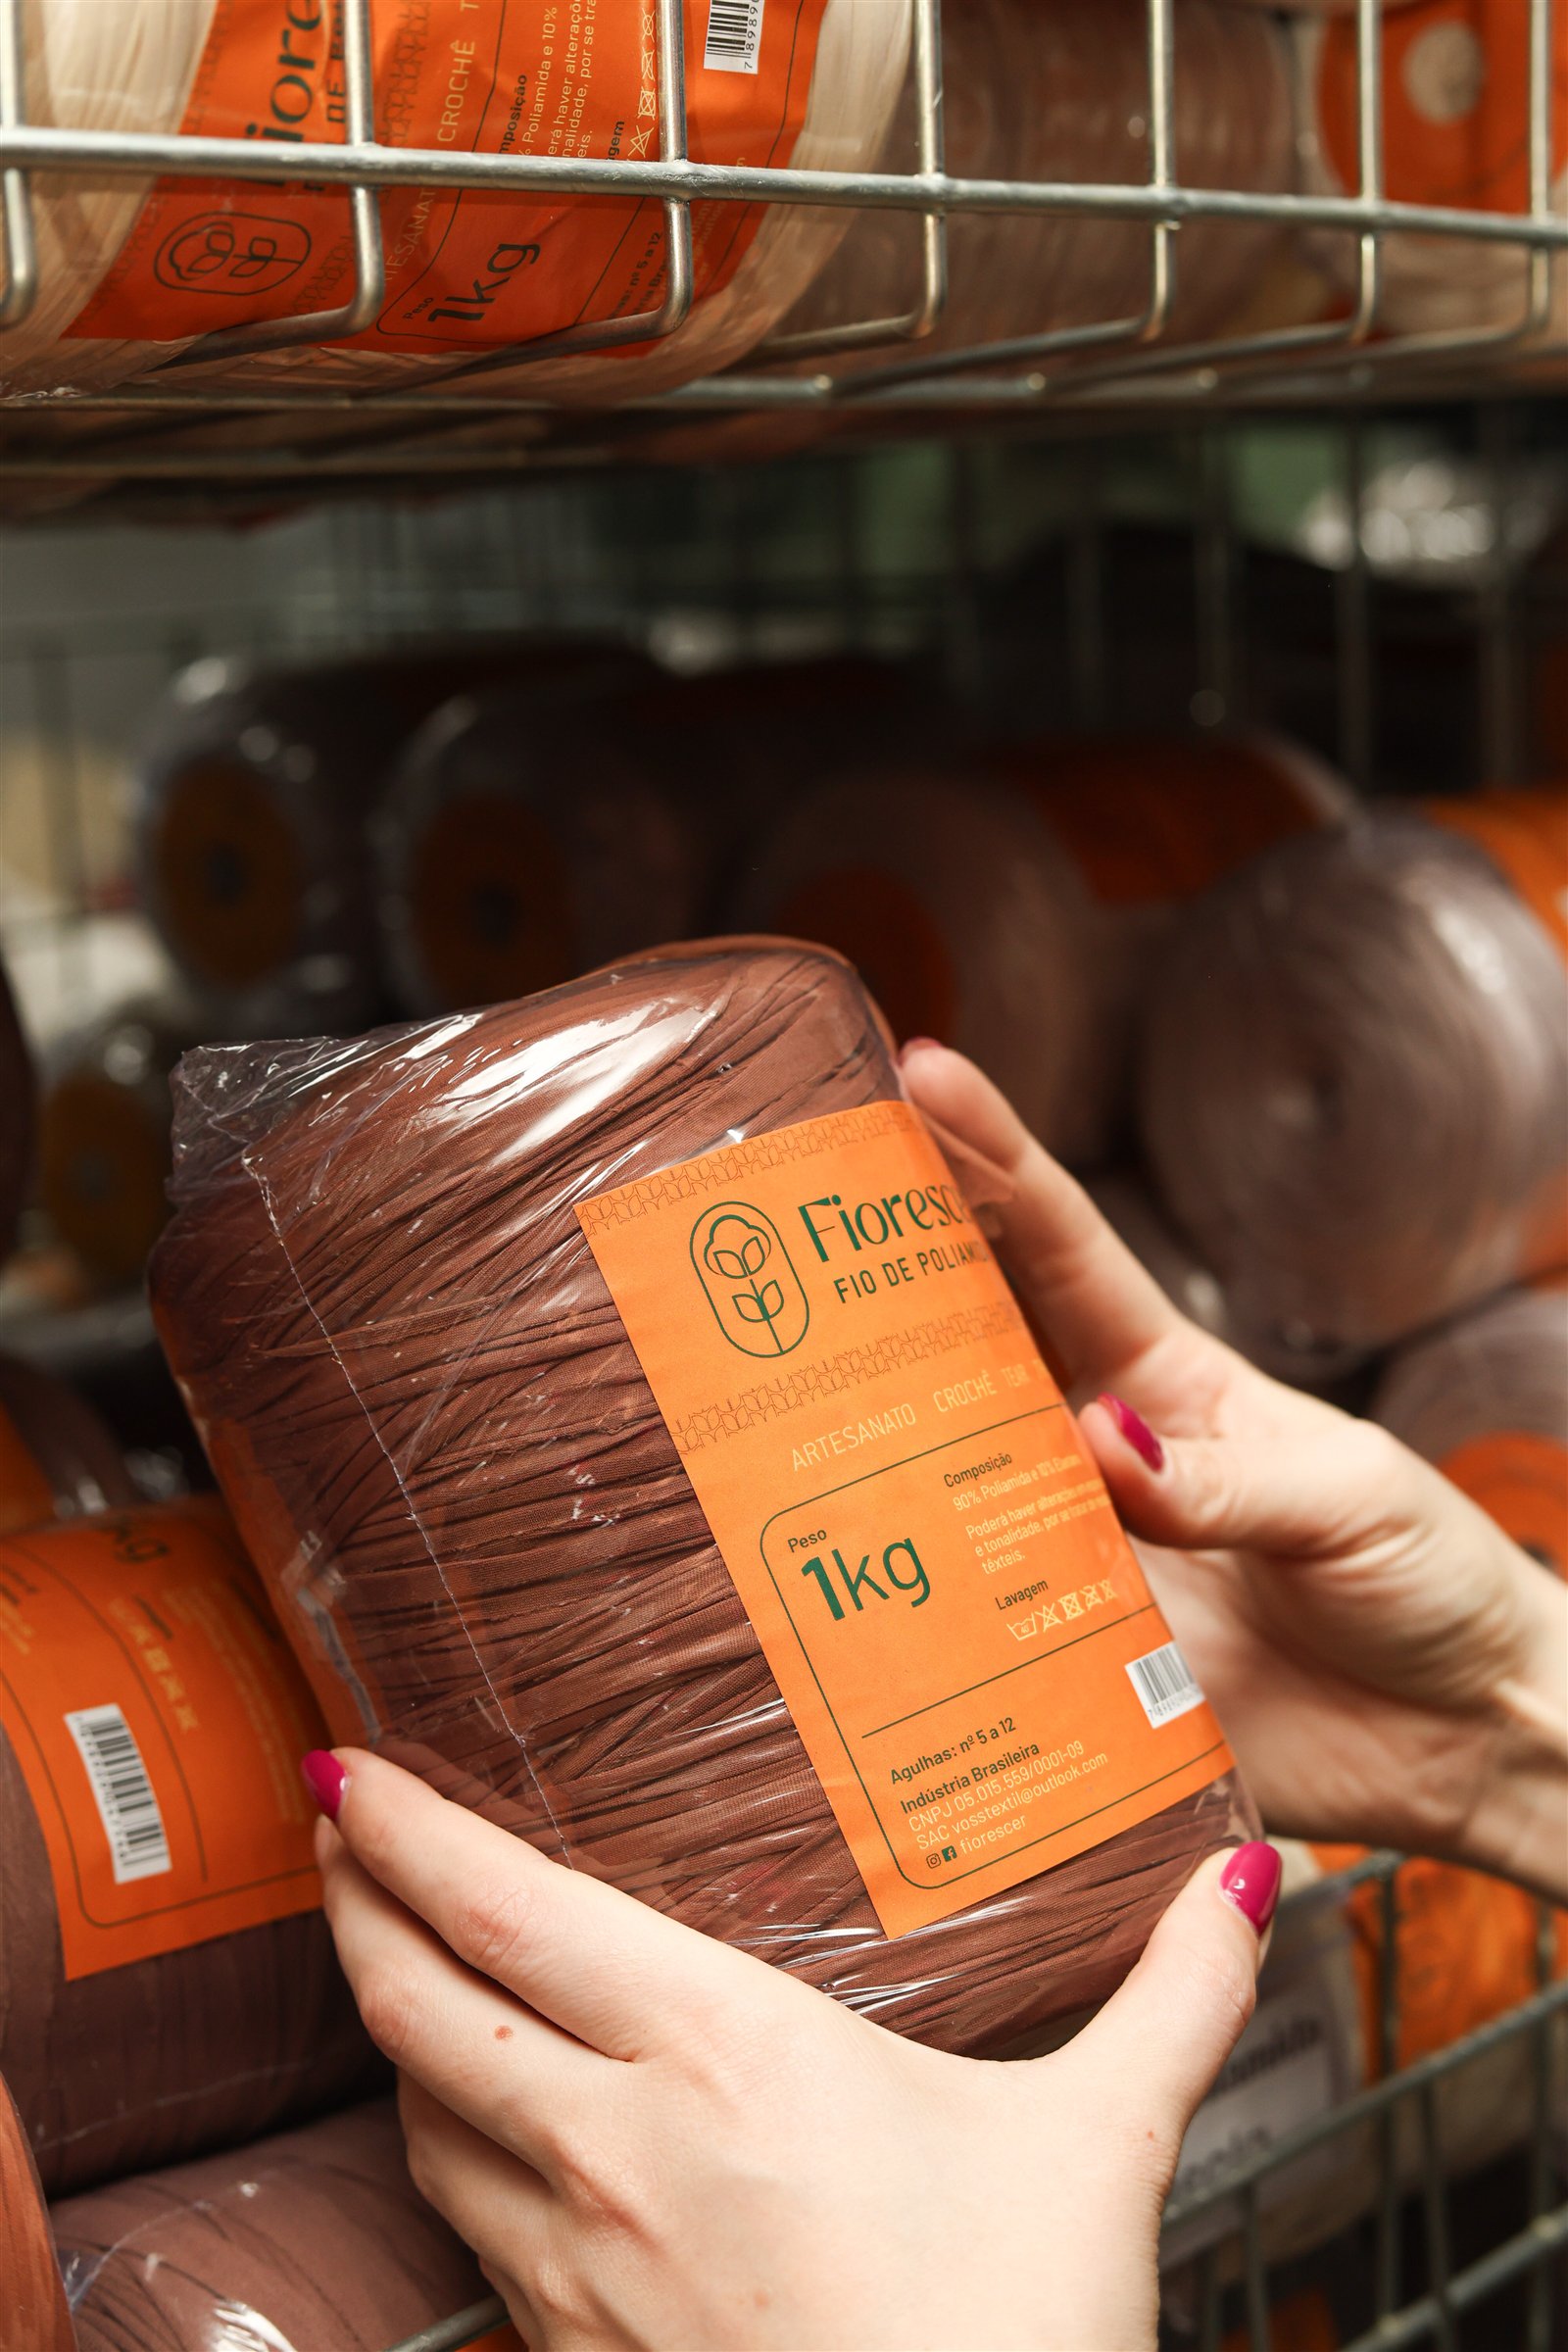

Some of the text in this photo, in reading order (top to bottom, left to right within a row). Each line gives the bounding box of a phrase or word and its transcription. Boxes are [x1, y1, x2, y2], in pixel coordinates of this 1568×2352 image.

[541, 7, 558, 39] 10%
[584, 25, 595, 45] se
[543, 46, 553, 56] e
[580, 48, 592, 78] por
[437, 40, 475, 142] CROCHÊ
[548, 0, 582, 155] erá haver alteraçõ
[499, 74, 527, 154] mposição
[521, 61, 552, 143] Poliamida
[562, 84, 588, 157] nalidade,
[577, 130, 593, 158] eis.
[427, 243, 541, 321] 1kg
[403, 297, 434, 320] Peso
[833, 1270, 877, 1304] FIO
[881, 1257, 914, 1288] DE
[792, 1403, 916, 1471] ARTESANATO
[933, 1372, 998, 1412] CROCHÊ
[944, 1452, 1012, 1488] Composição
[953, 1491, 982, 1511] 90%
[980, 1471, 1032, 1499] Poliamida
[787, 1530, 827, 1553] Peso
[965, 1512, 1008, 1540] Poderá
[1007, 1500, 1037, 1524] haver
[974, 1544, 983, 1557] e
[983, 1520, 1045, 1553] tonalidade,
[1043, 1513, 1059, 1532] por
[801, 1538, 931, 1622] 1kg
[981, 1548, 1026, 1575] têxteis.
[995, 1580, 1049, 1610] Lavagem
[890, 1717, 1016, 1785] Agulhas: nº 5 a 12
[900, 1742, 1040, 1814] Indústria Brasileira
[908, 1740, 1084, 1833] CNPJ 05.015.559/0001-09
[916, 1752, 1108, 1850] SAC vosstextil@outlook.com
[959, 1814, 1026, 1854] fiorescer
